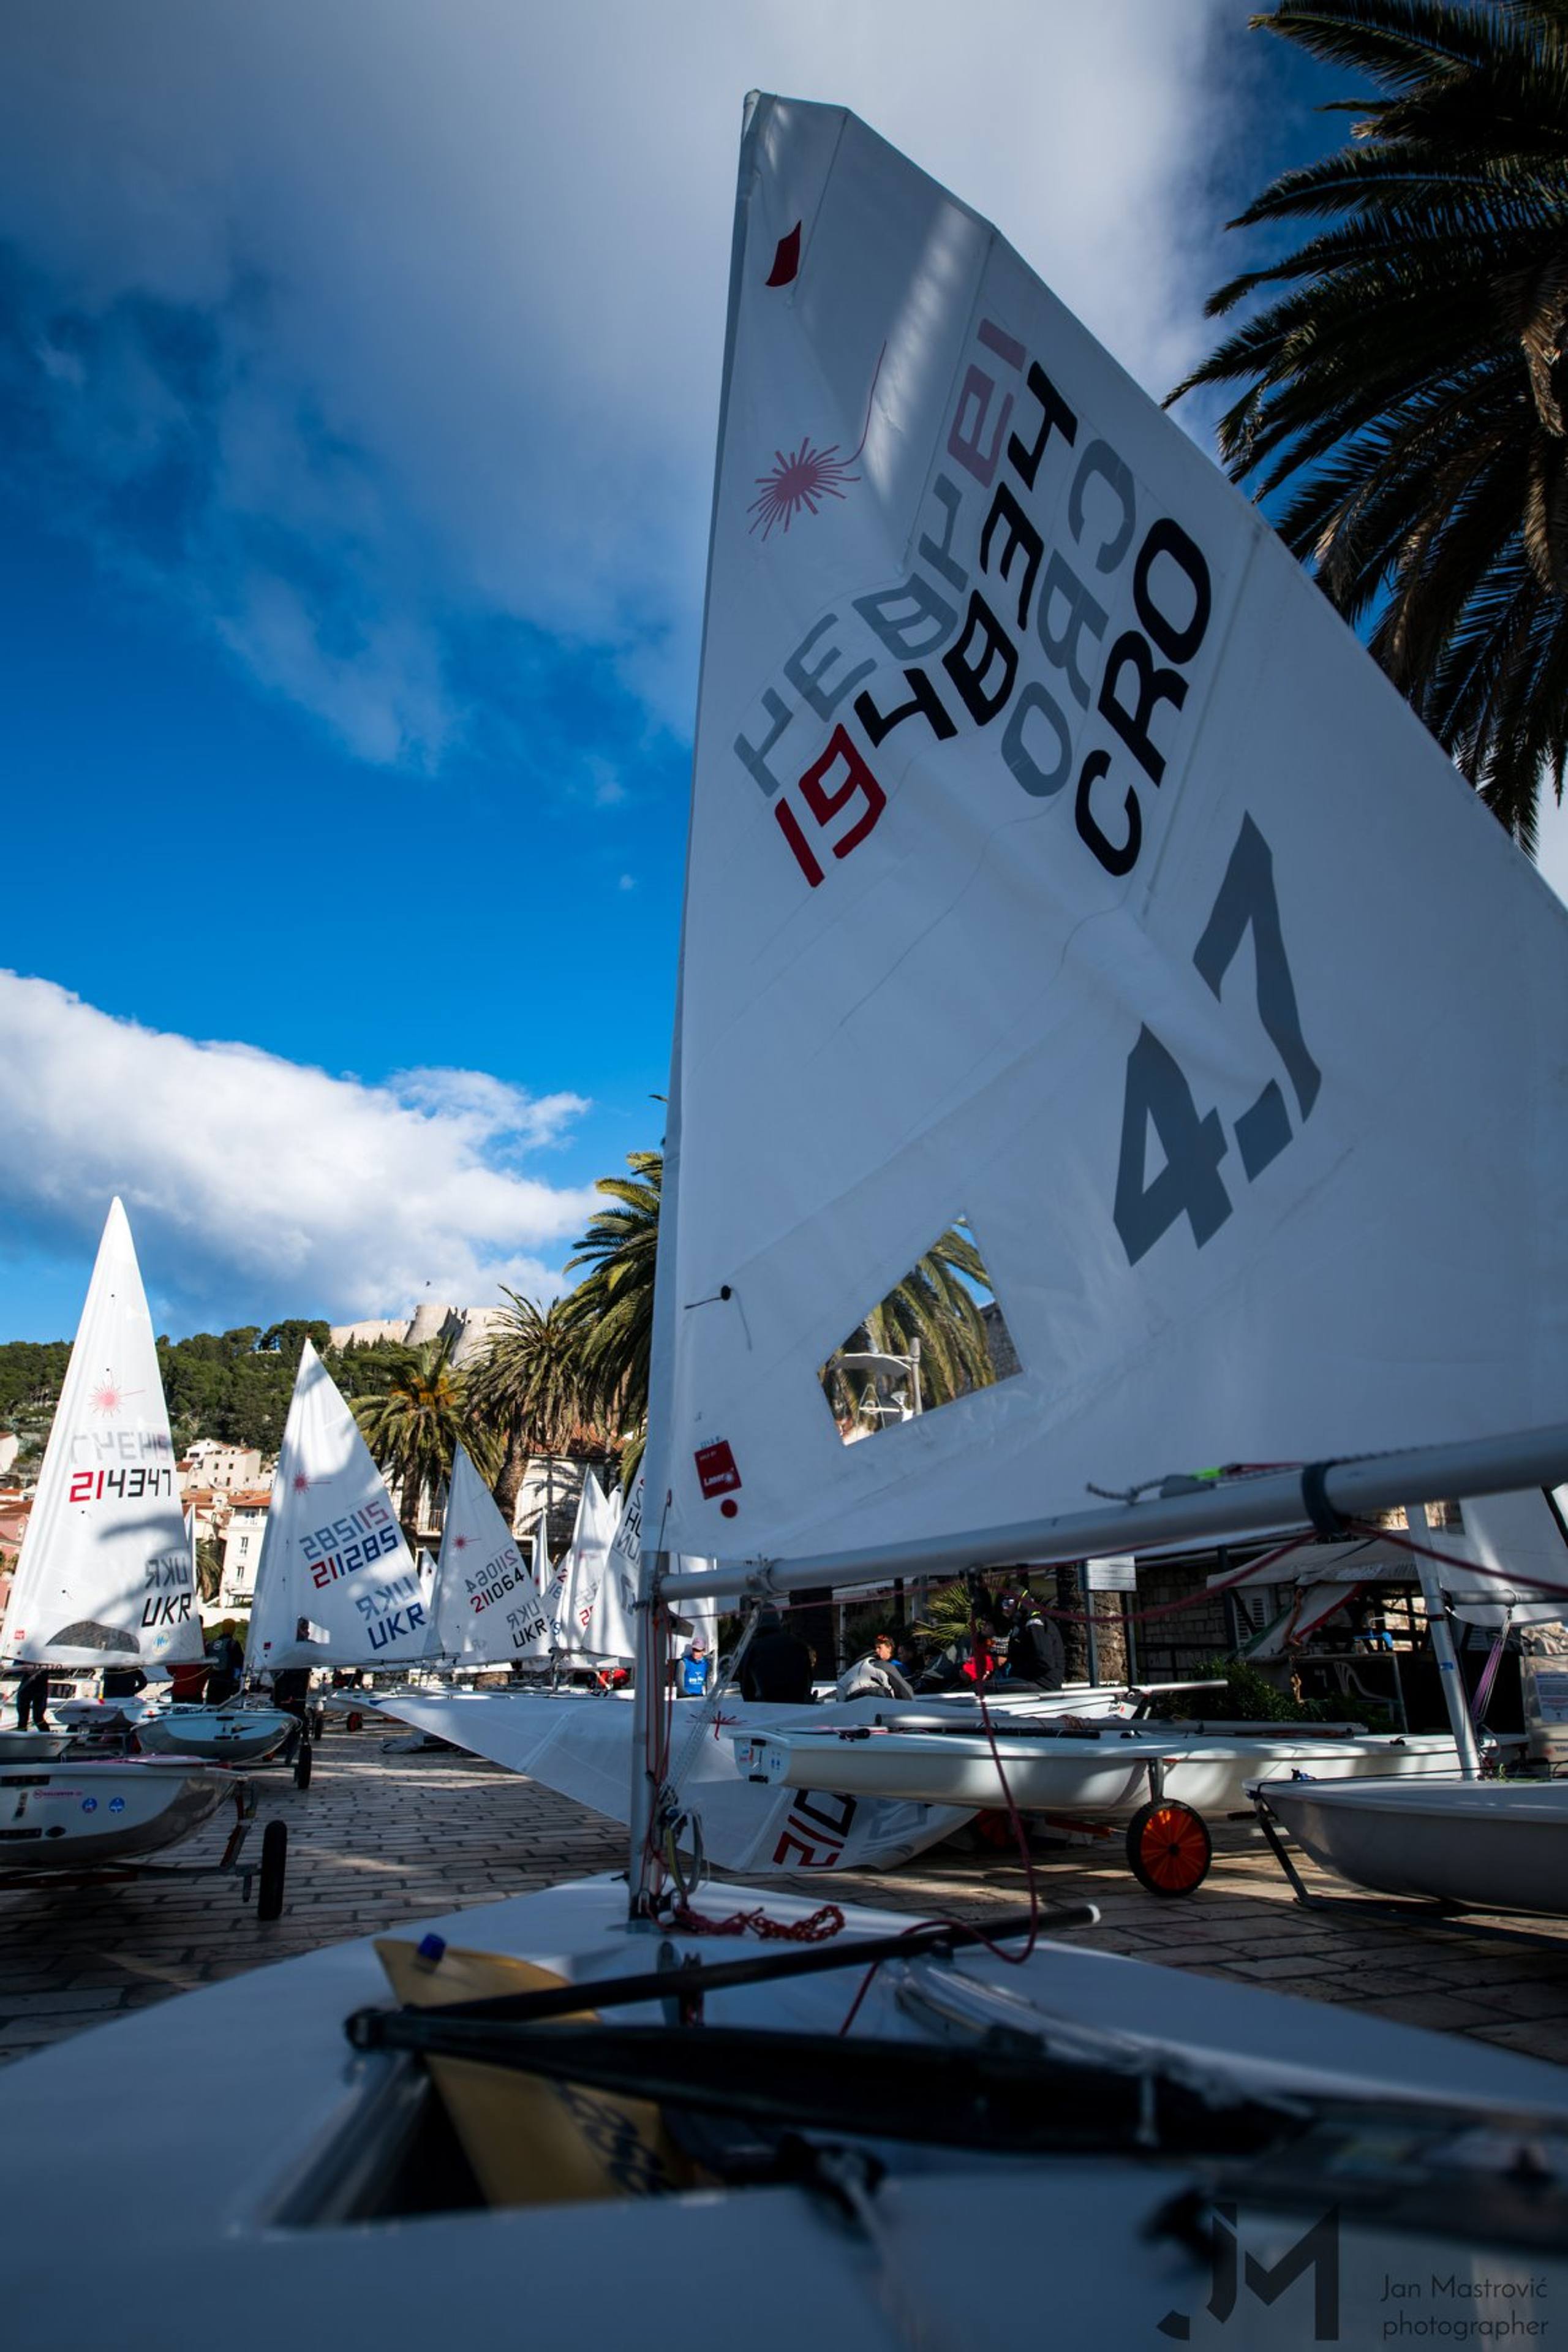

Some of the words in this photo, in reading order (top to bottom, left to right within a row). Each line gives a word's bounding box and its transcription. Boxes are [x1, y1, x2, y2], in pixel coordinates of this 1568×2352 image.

[774, 360, 1078, 888] 194834
[1075, 517, 1212, 877] CRO
[1113, 809, 1321, 1268] 4.7
[69, 1468, 172, 1503] 214347
[310, 1524, 399, 1589] 211285
[140, 1593, 192, 1627] UKR
[470, 1567, 526, 1614] 211064
[367, 1601, 427, 1651] UKR
[512, 1617, 548, 1649] UKR
